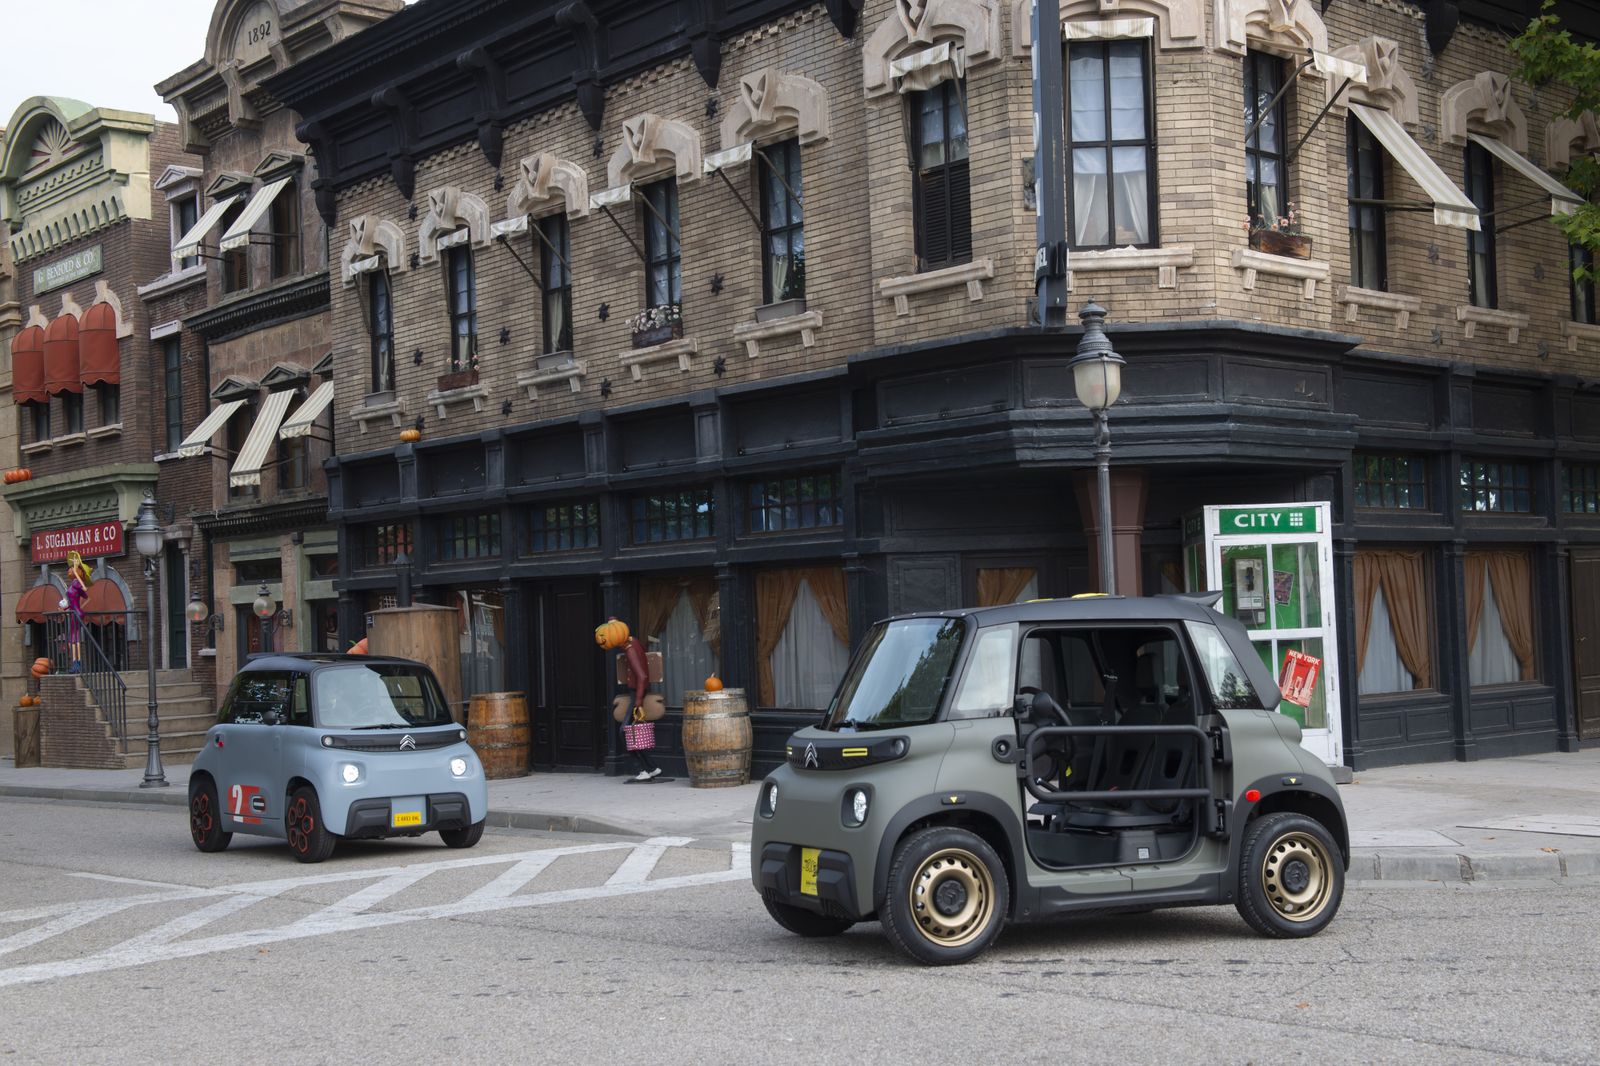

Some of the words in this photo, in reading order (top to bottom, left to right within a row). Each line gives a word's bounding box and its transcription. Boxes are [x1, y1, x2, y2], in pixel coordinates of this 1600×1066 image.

[248, 20, 271, 45] 1892
[1234, 513, 1282, 528] CITY
[36, 537, 43, 550] L.
[45, 530, 92, 549] SUGARMAN
[94, 528, 100, 543] &
[103, 526, 116, 541] CO
[1288, 650, 1304, 660] NEW
[1303, 654, 1321, 665] YORK
